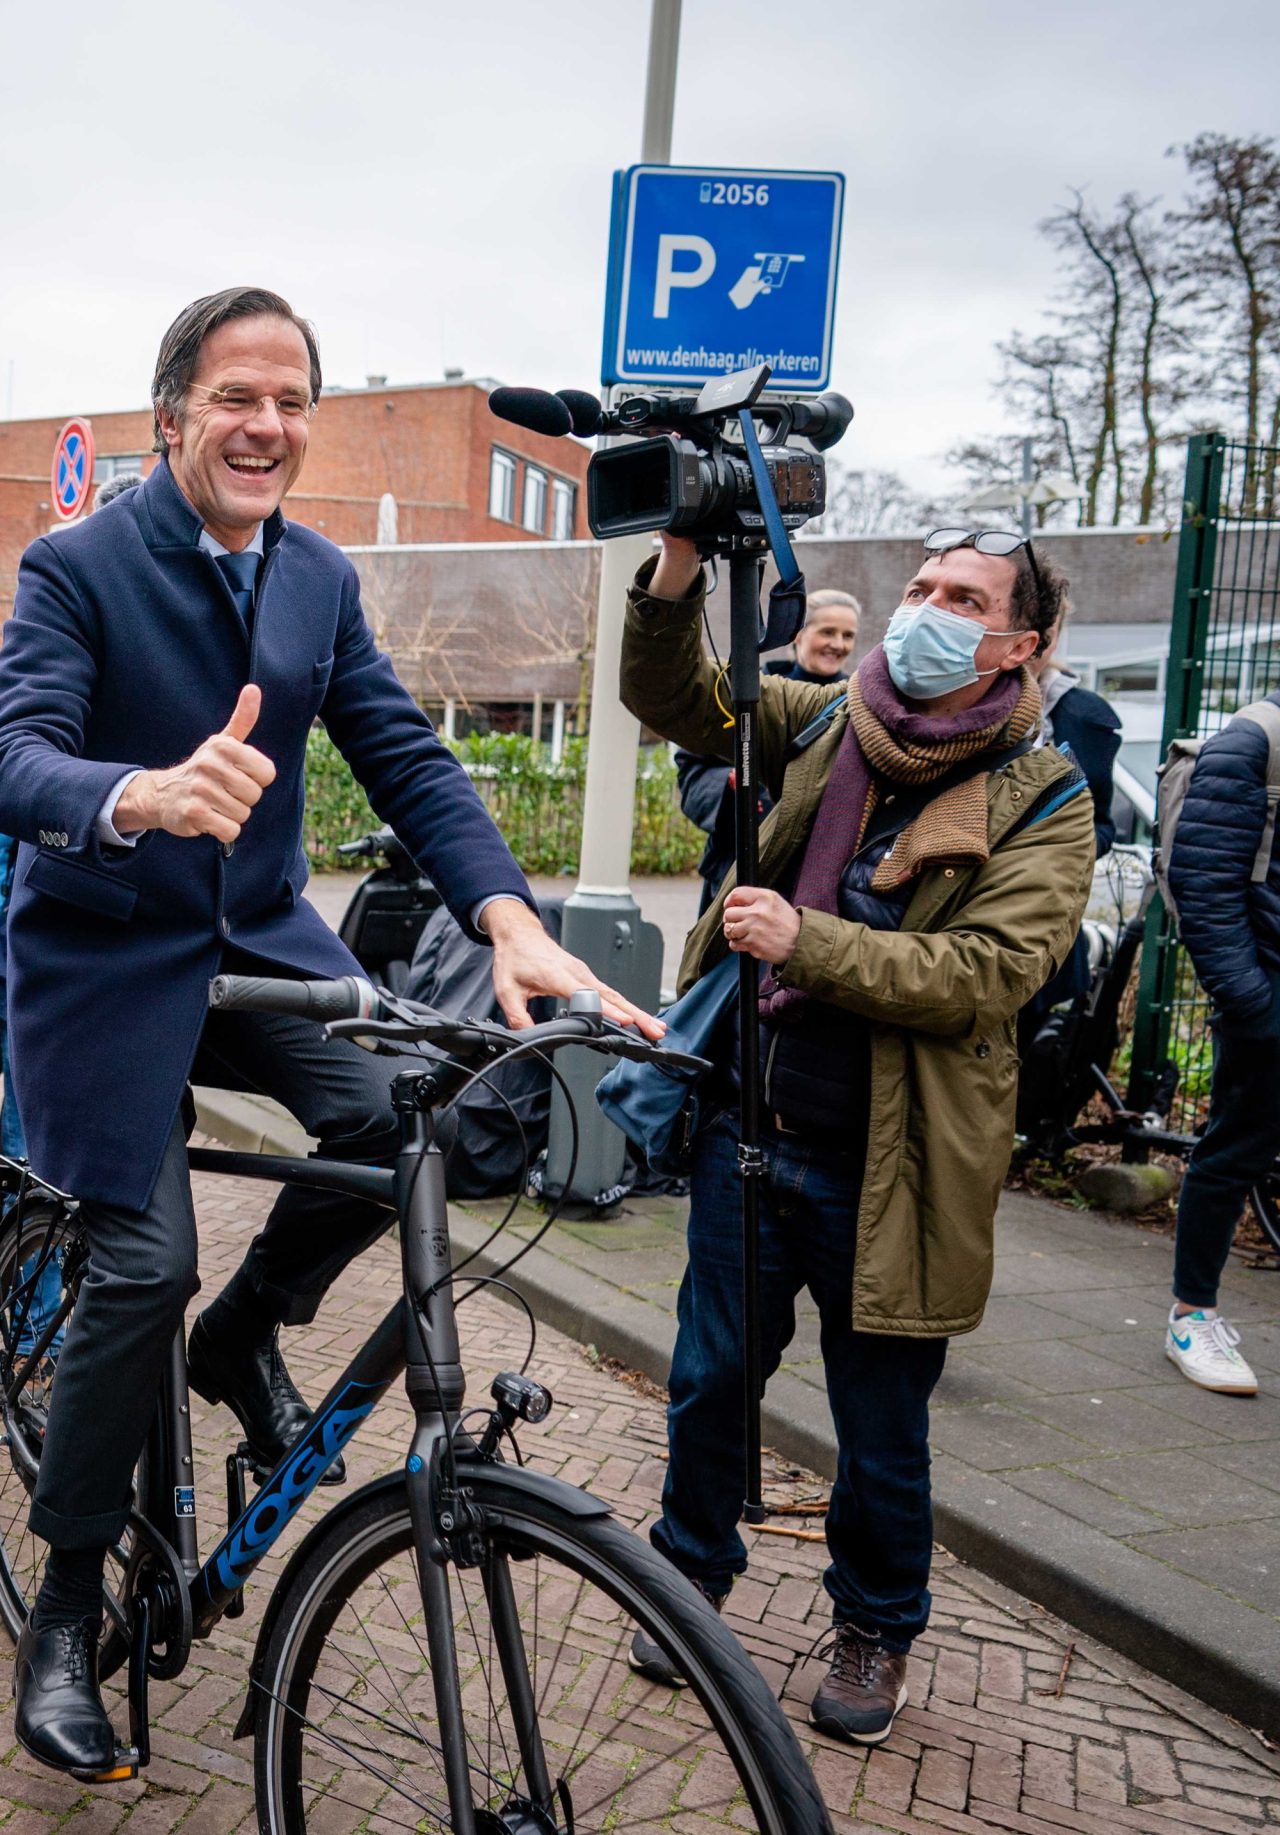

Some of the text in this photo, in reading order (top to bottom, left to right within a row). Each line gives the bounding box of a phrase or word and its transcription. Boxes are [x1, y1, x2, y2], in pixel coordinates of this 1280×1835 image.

[712, 183, 769, 206] 2056
[653, 234, 716, 319] P
[217, 1401, 375, 1589] KOGA
